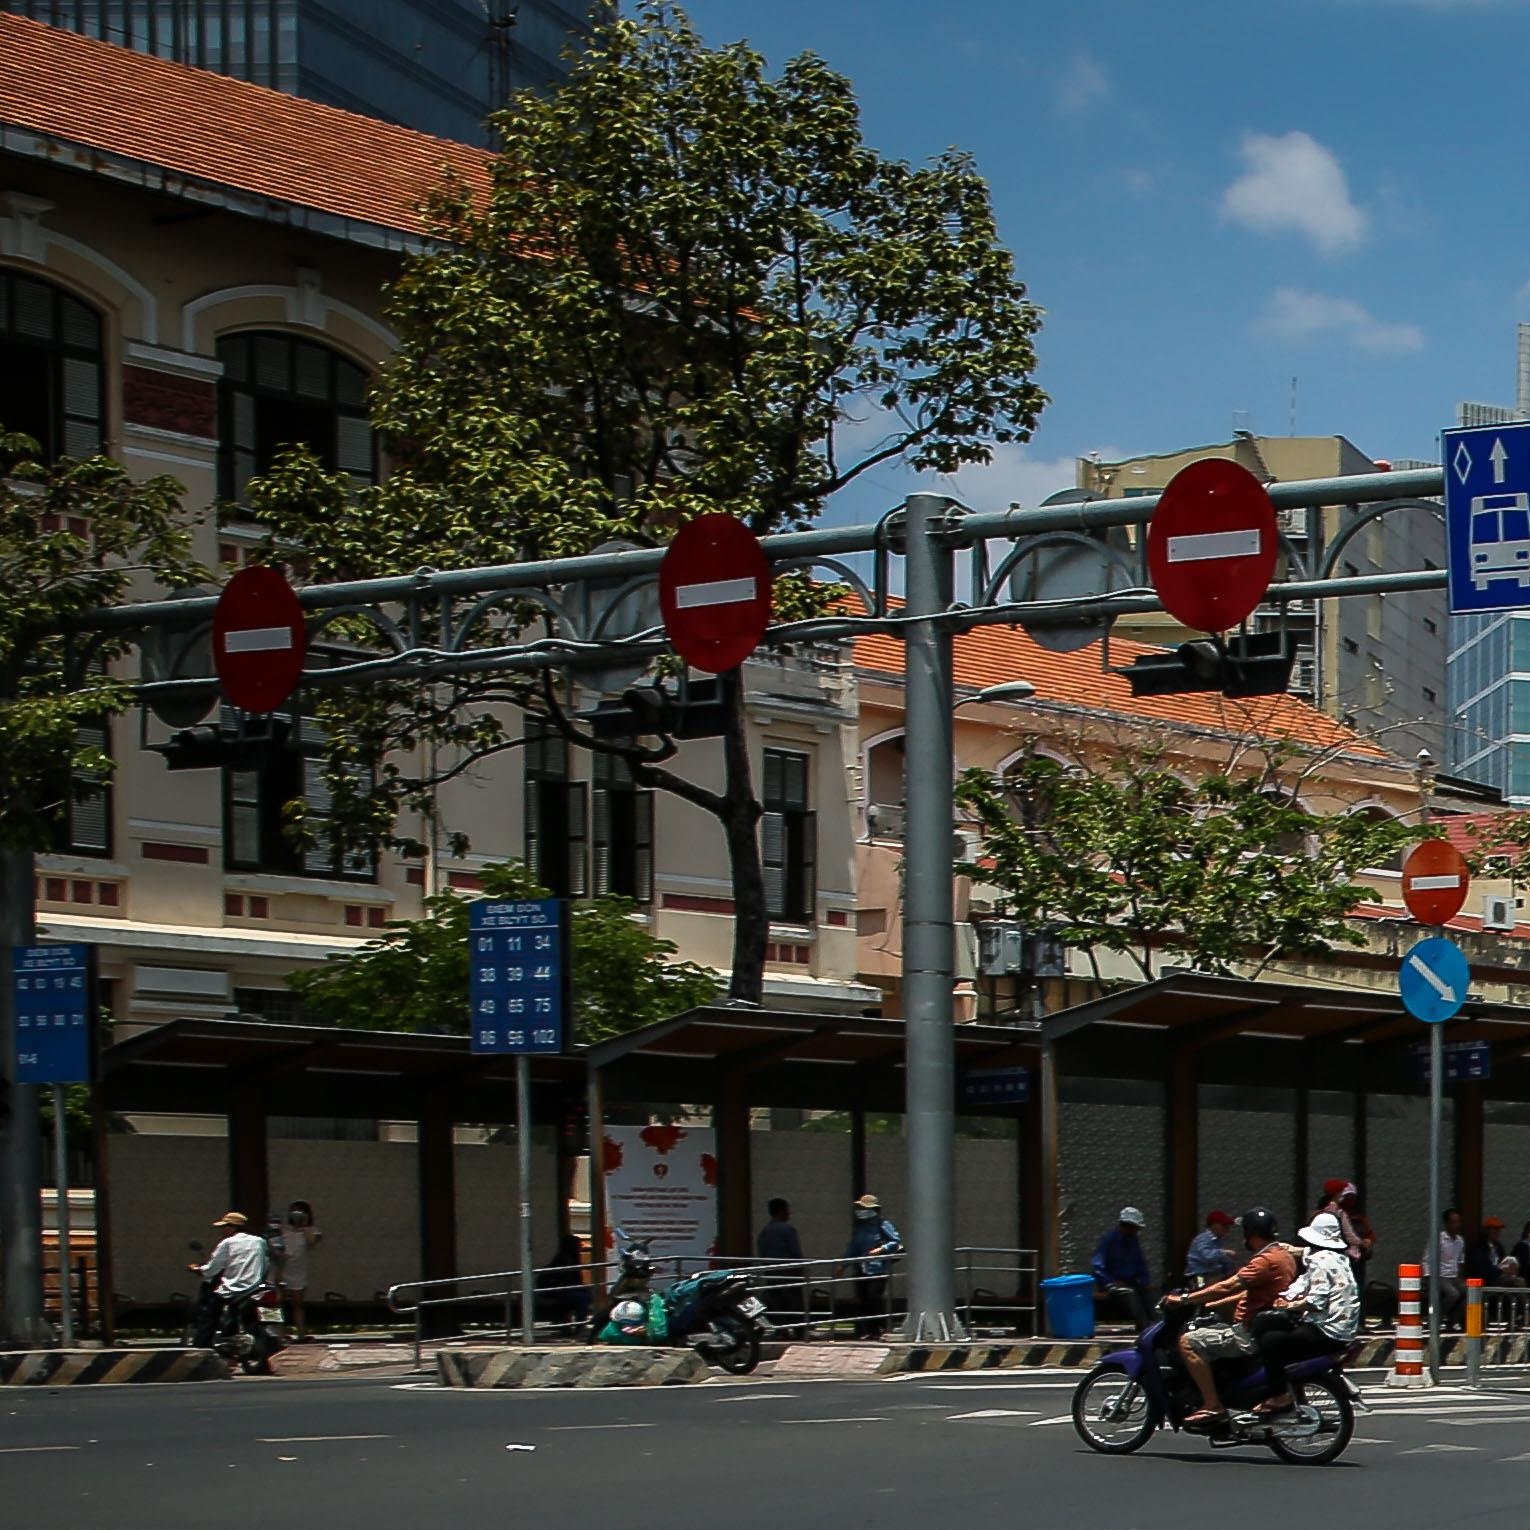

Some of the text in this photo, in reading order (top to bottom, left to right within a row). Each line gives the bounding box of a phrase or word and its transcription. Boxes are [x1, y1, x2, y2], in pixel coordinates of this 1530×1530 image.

[506, 935, 522, 951] 11
[534, 935, 551, 950] 34
[533, 966, 551, 980] 44
[534, 997, 552, 1012] 75
